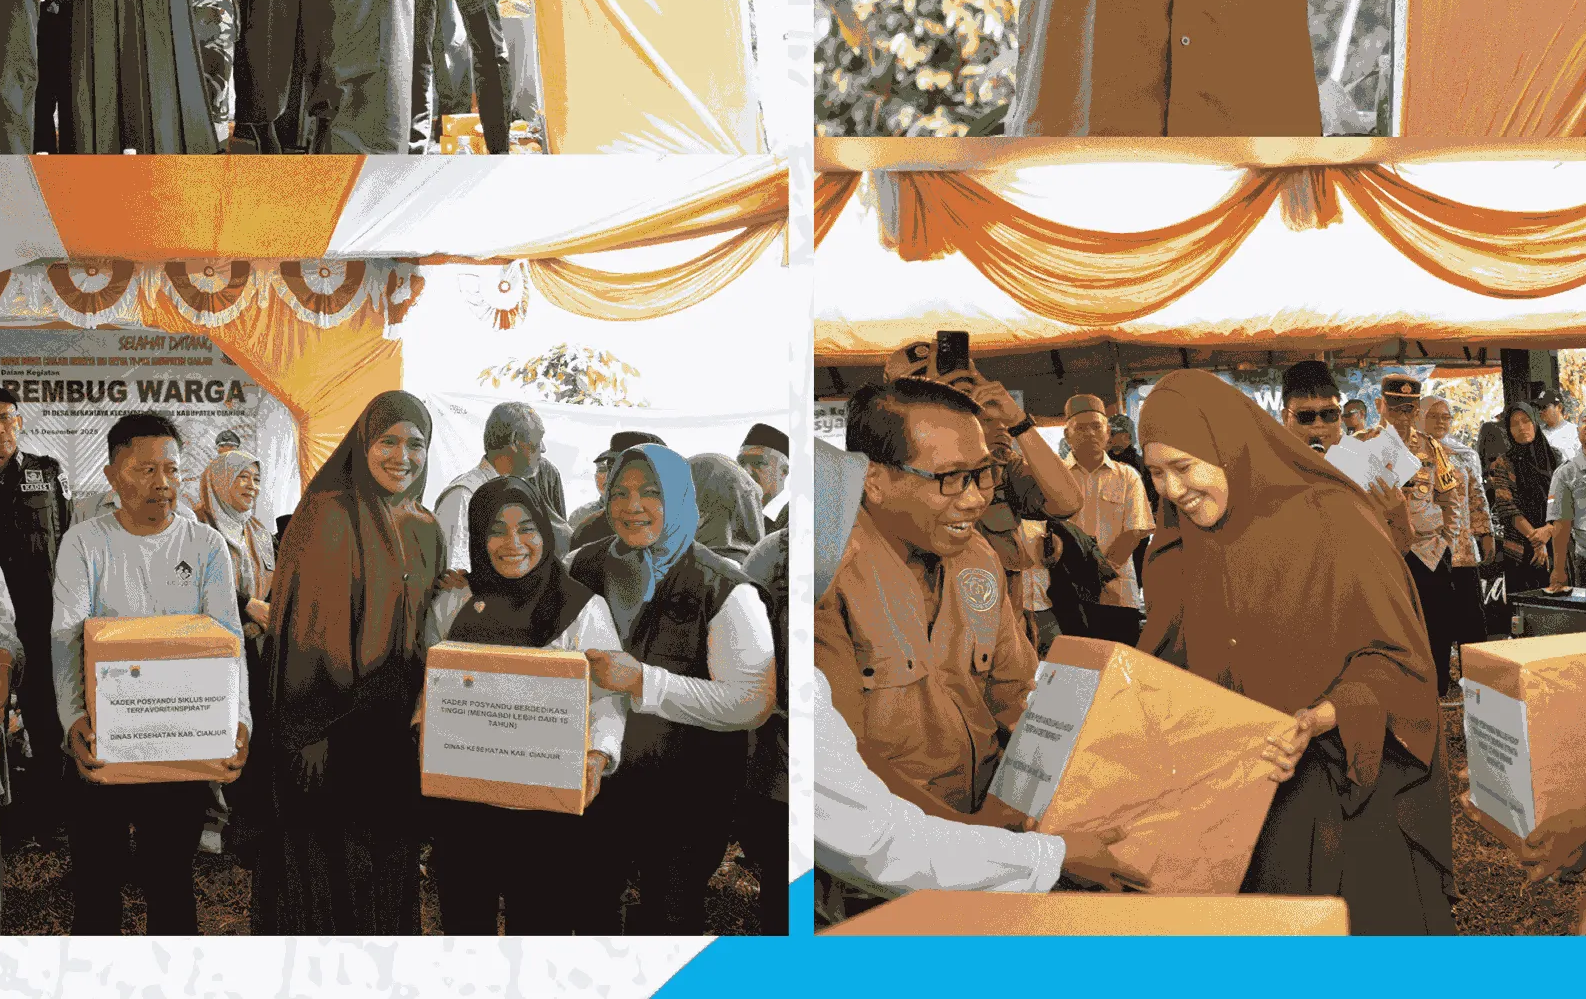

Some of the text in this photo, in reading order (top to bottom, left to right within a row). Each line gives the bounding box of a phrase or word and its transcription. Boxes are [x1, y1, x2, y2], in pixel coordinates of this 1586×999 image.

[118, 335, 166, 352] SELAMAT
[2, 380, 247, 404] REMBUG WARGA
[442, 698, 467, 706] KADER
[469, 700, 512, 710] POSYANDU
